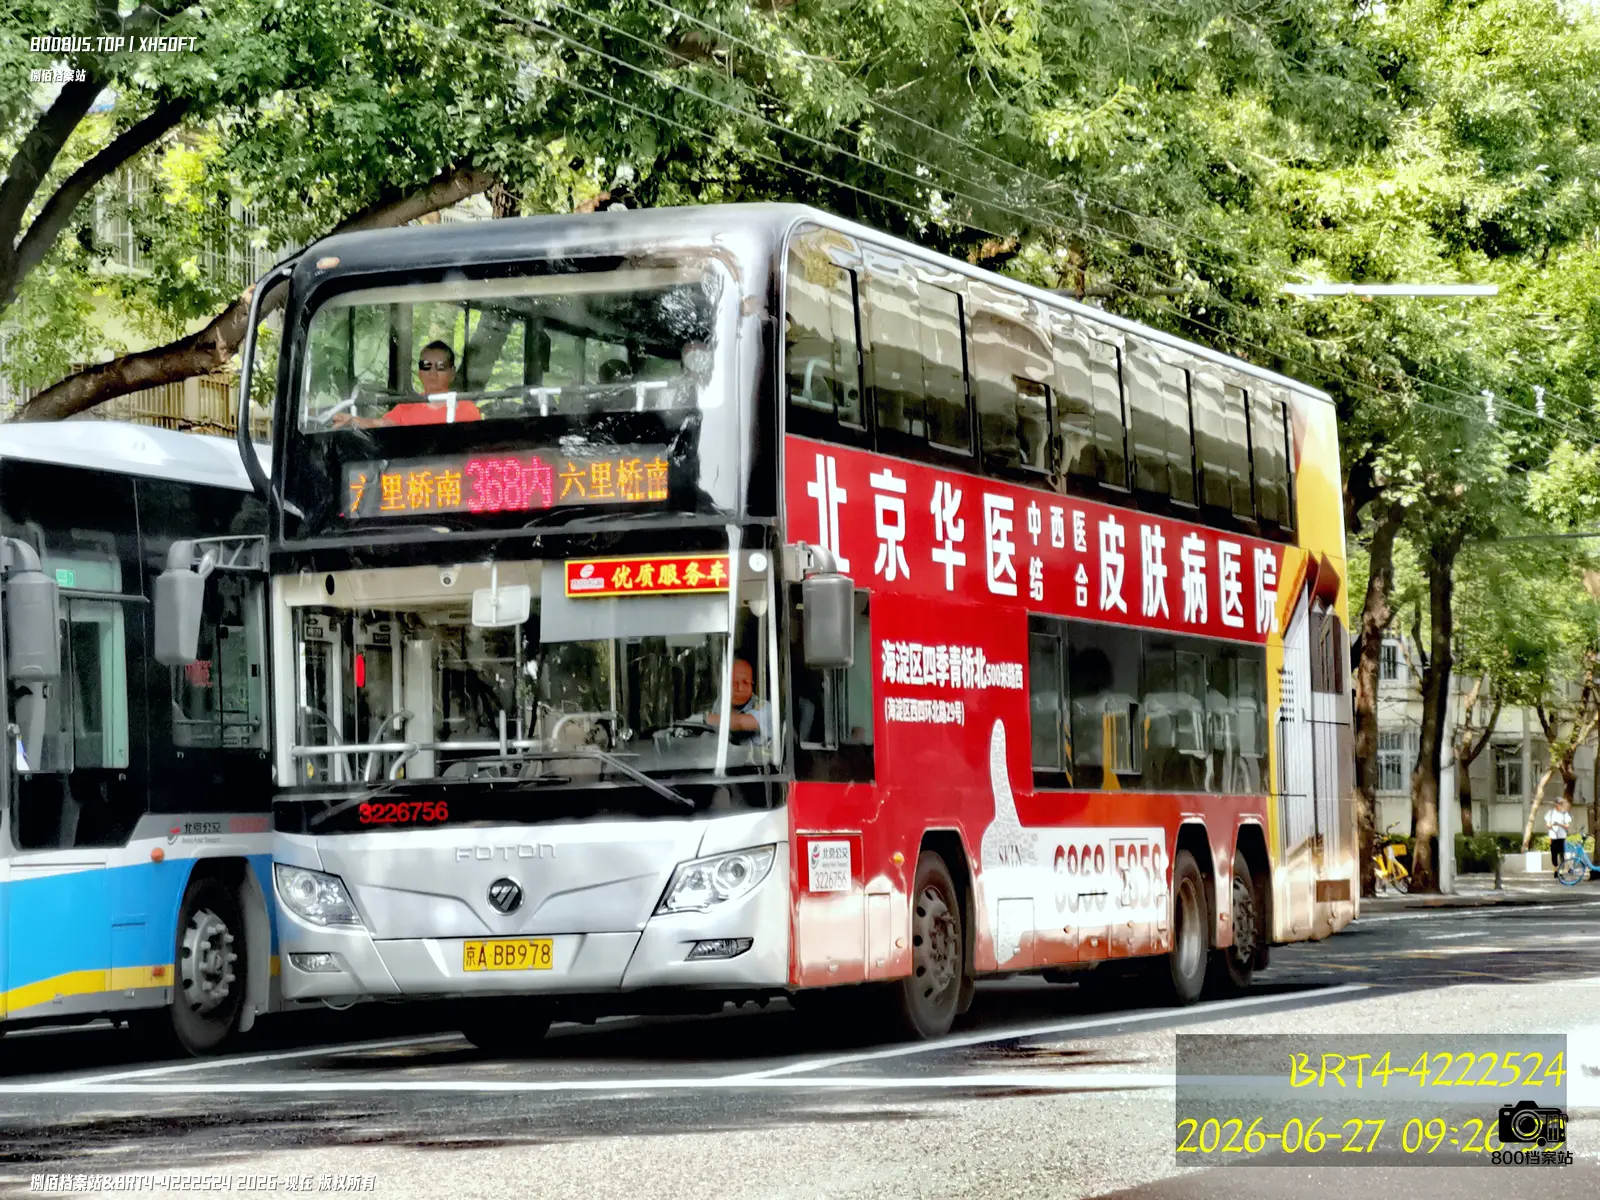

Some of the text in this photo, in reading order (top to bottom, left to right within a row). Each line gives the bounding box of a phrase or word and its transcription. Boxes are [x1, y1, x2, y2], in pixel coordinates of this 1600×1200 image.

[466, 456, 552, 512] 368内
[559, 455, 668, 500] 六里桥南
[807, 453, 1017, 596] 北京华医
[1027, 500, 1087, 552] 中西医
[611, 560, 728, 588] 优质服务车
[1099, 514, 1278, 634] 皮肤病医院
[359, 801, 448, 824] 3226756
[455, 842, 556, 862] FOTON
